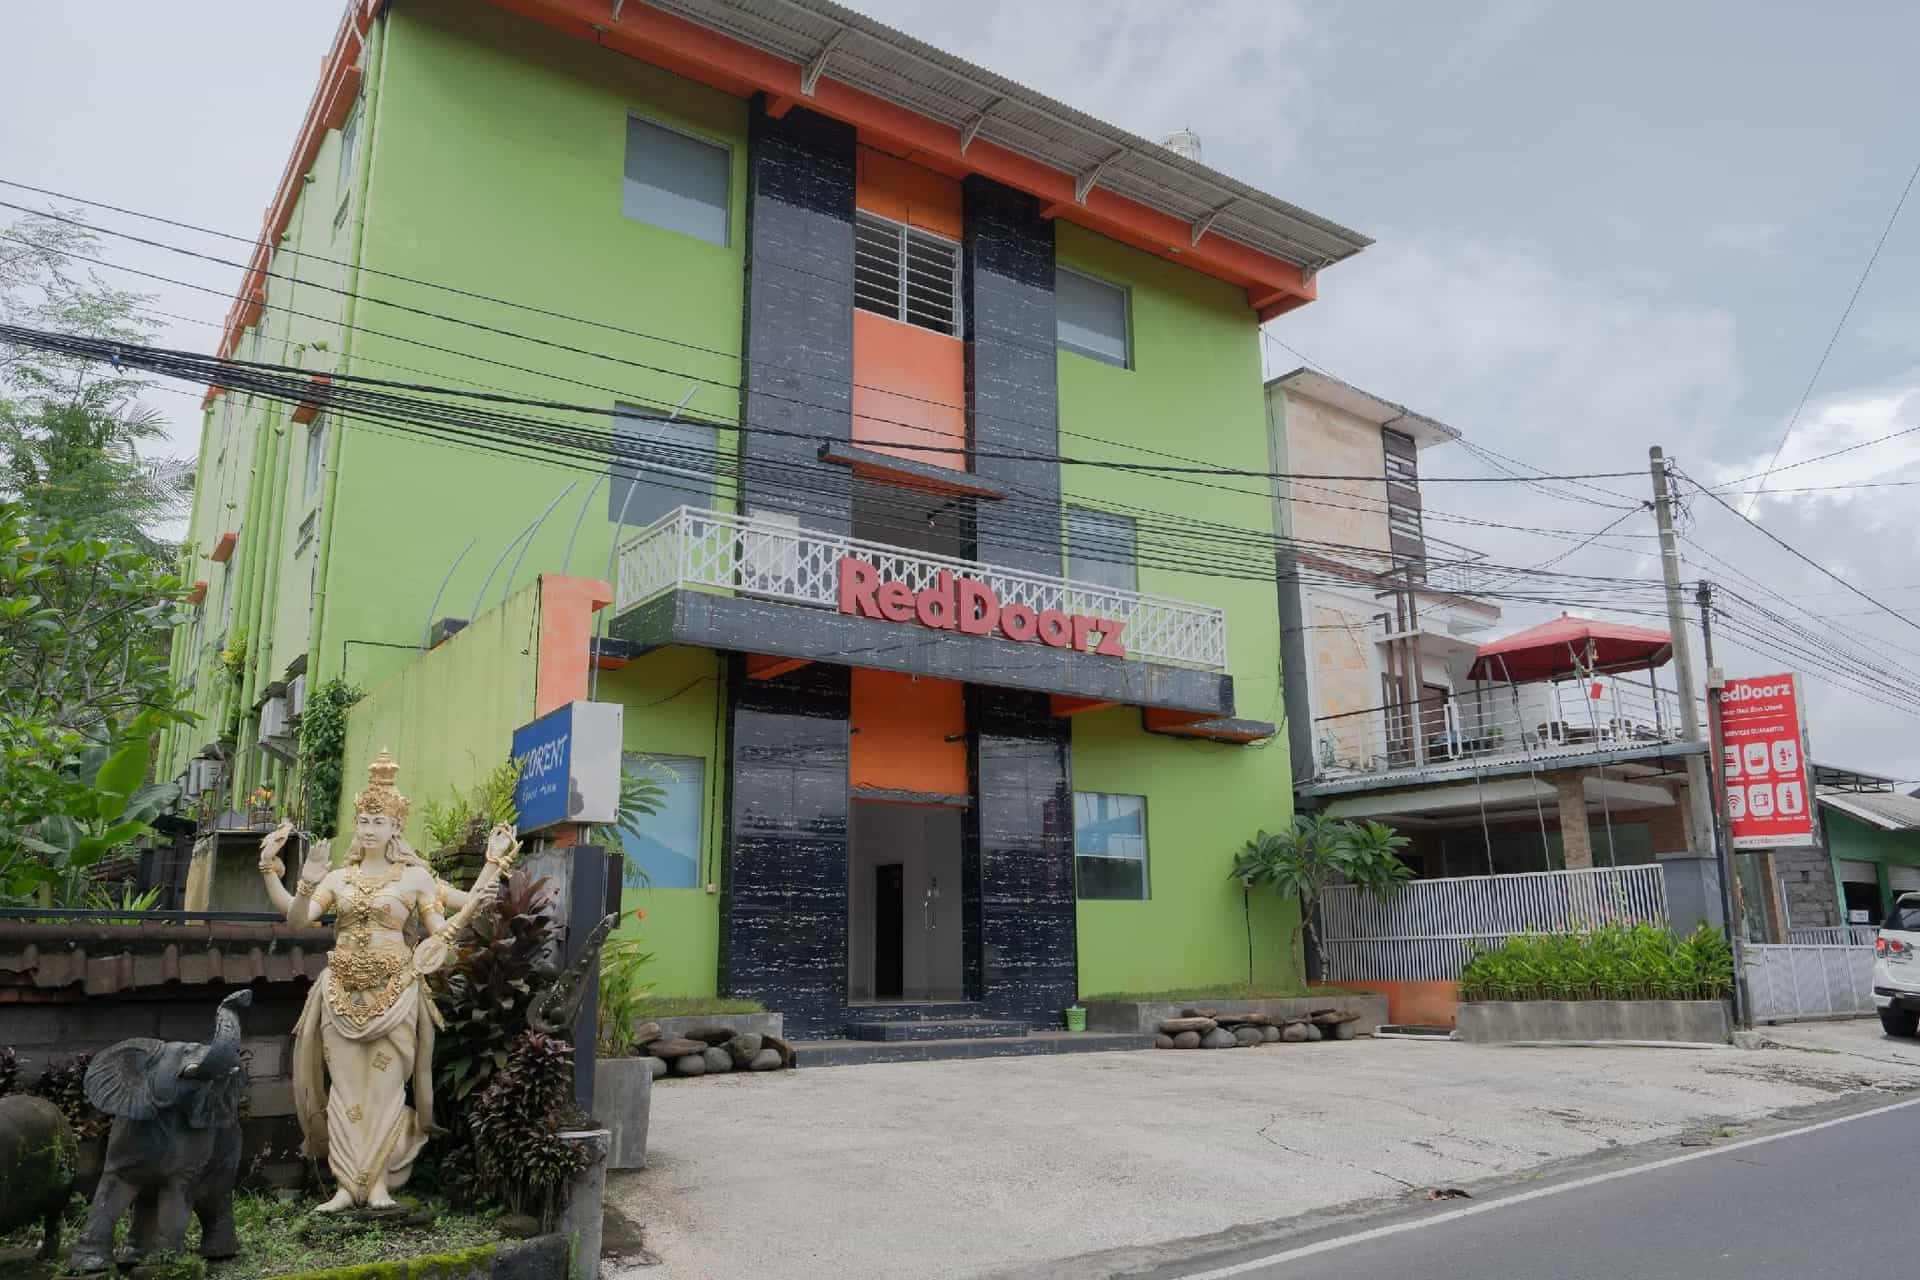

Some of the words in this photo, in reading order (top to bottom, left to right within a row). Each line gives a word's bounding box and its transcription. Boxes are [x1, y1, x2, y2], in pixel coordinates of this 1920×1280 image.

[838, 556, 1126, 658] RedDoorz
[1719, 683, 1792, 703] edDoorz
[520, 733, 568, 781] LORENT
